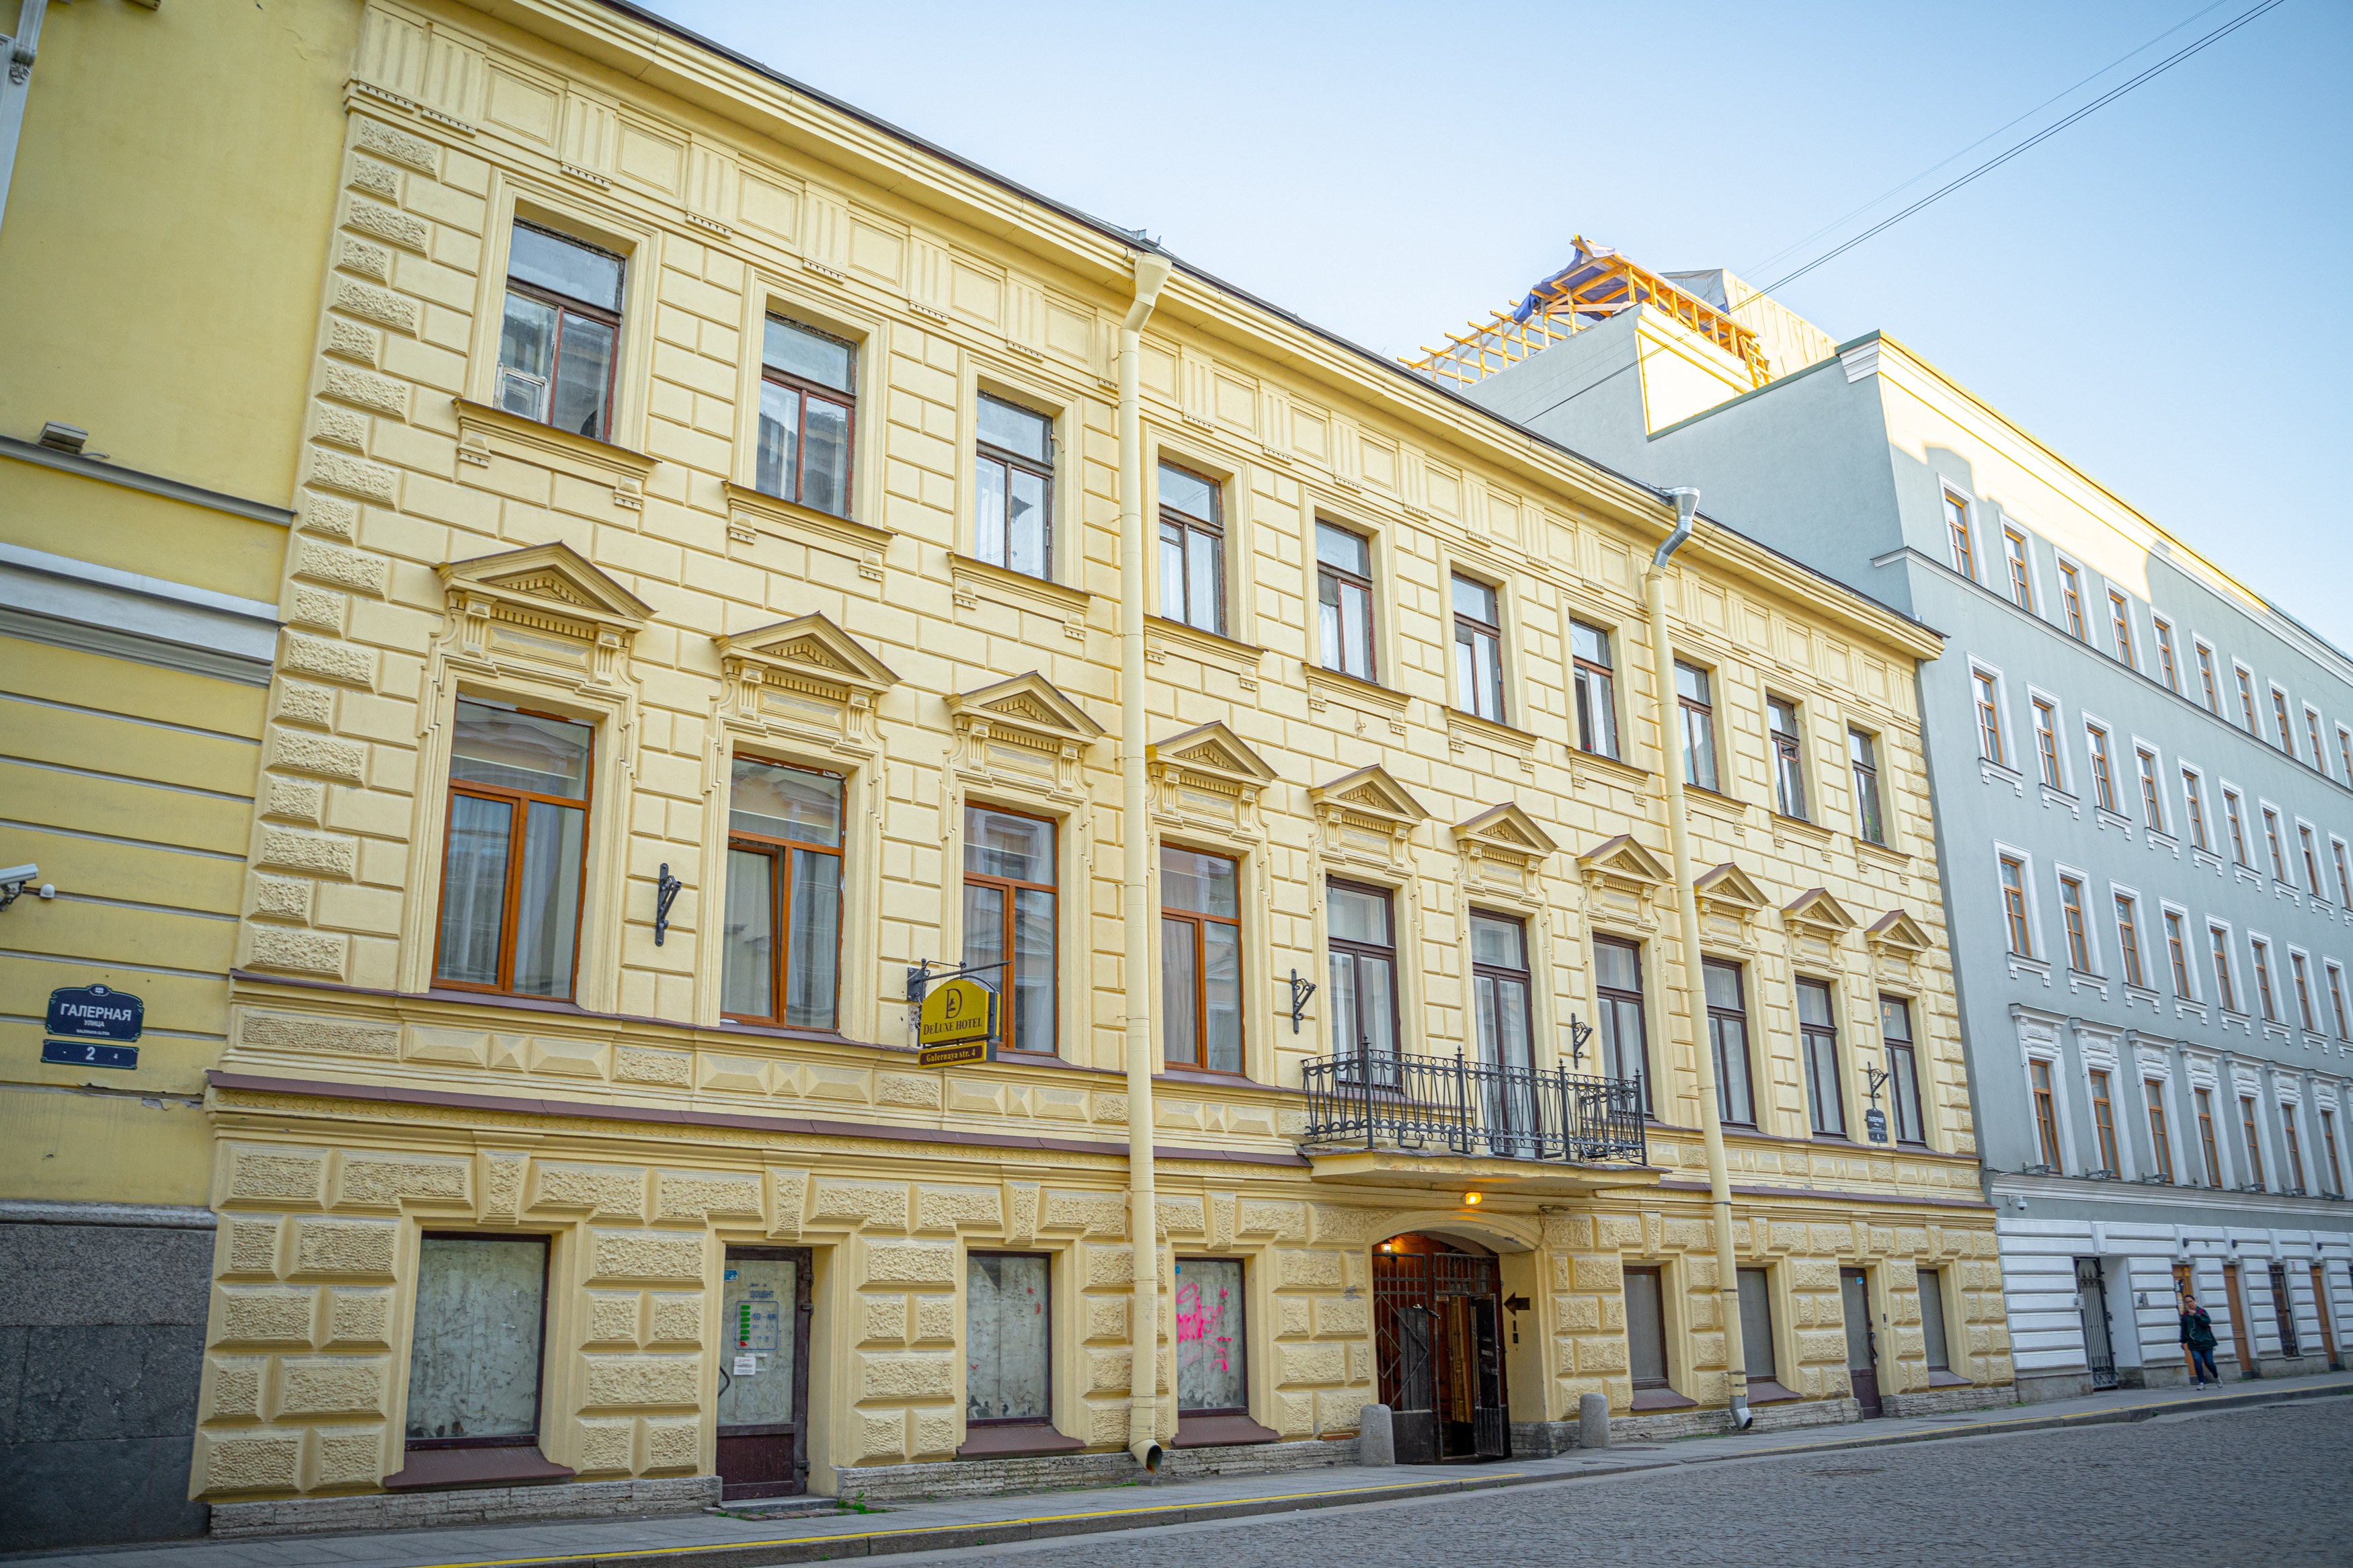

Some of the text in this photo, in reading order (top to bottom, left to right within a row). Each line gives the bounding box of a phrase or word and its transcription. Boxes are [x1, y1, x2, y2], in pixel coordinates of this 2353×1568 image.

[945, 988, 963, 1019] D
[60, 1003, 132, 1021] ГАЛЕРНАЯ
[84, 1019, 105, 1028] УЛИЦА
[923, 1018, 982, 1035] DELUXE HOTEL
[85, 1046, 95, 1061] 2
[926, 1048, 975, 1062] Galernaya str. 4
[750, 1290, 774, 1299] ДОЦЕНТ
